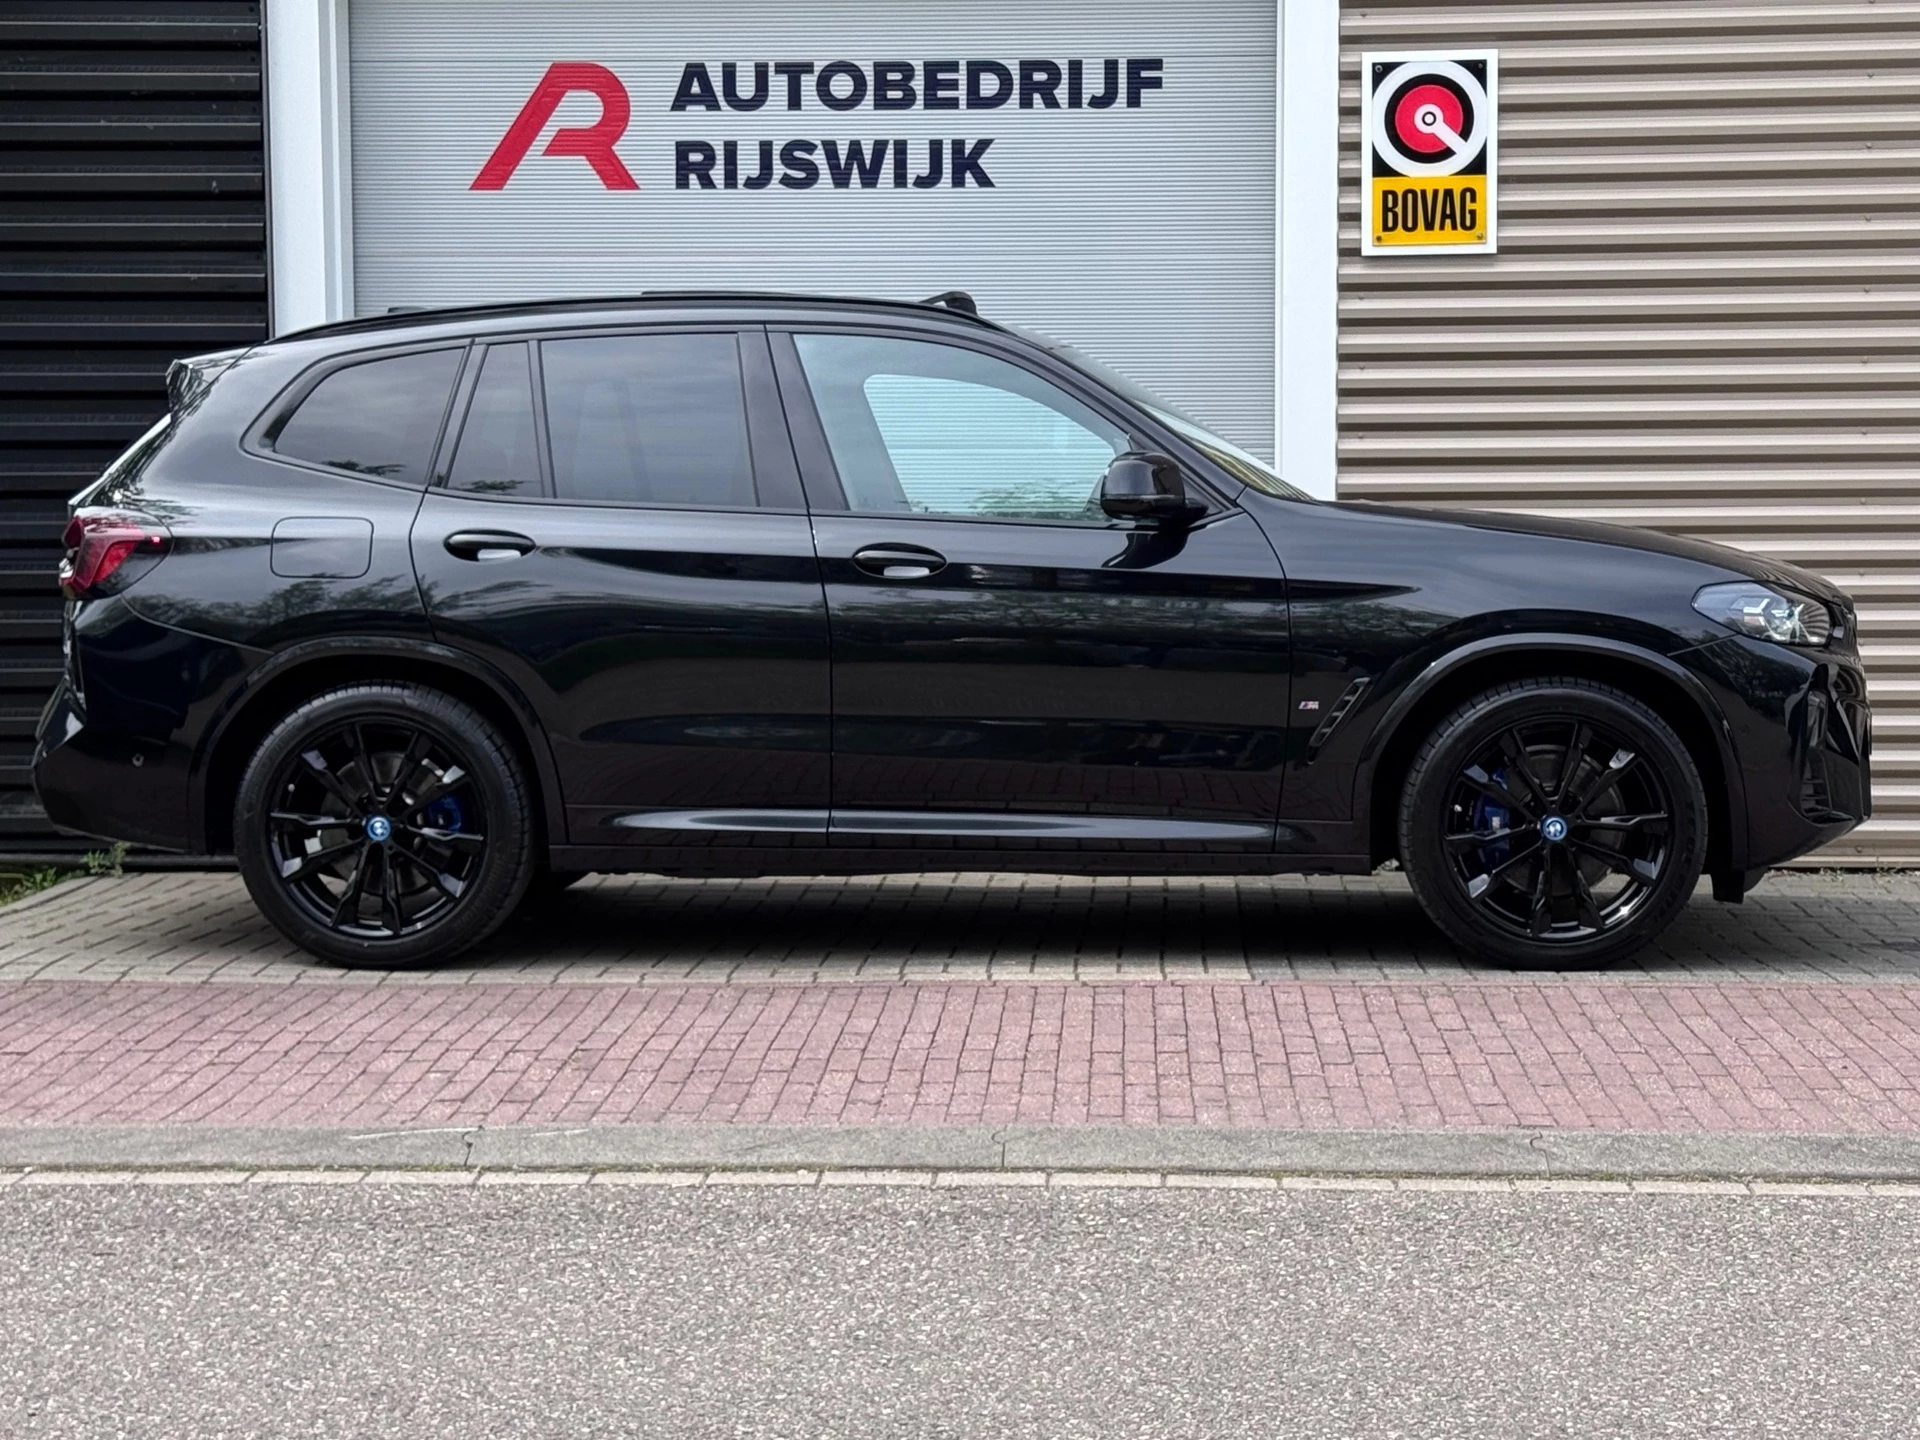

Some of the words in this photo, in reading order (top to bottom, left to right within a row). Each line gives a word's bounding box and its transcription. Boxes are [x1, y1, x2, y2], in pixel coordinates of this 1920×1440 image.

[670, 57, 1165, 112] AUTOBEDRIJF
[674, 138, 997, 191] RIJSWIJK
[1381, 187, 1477, 232] BOVAG
